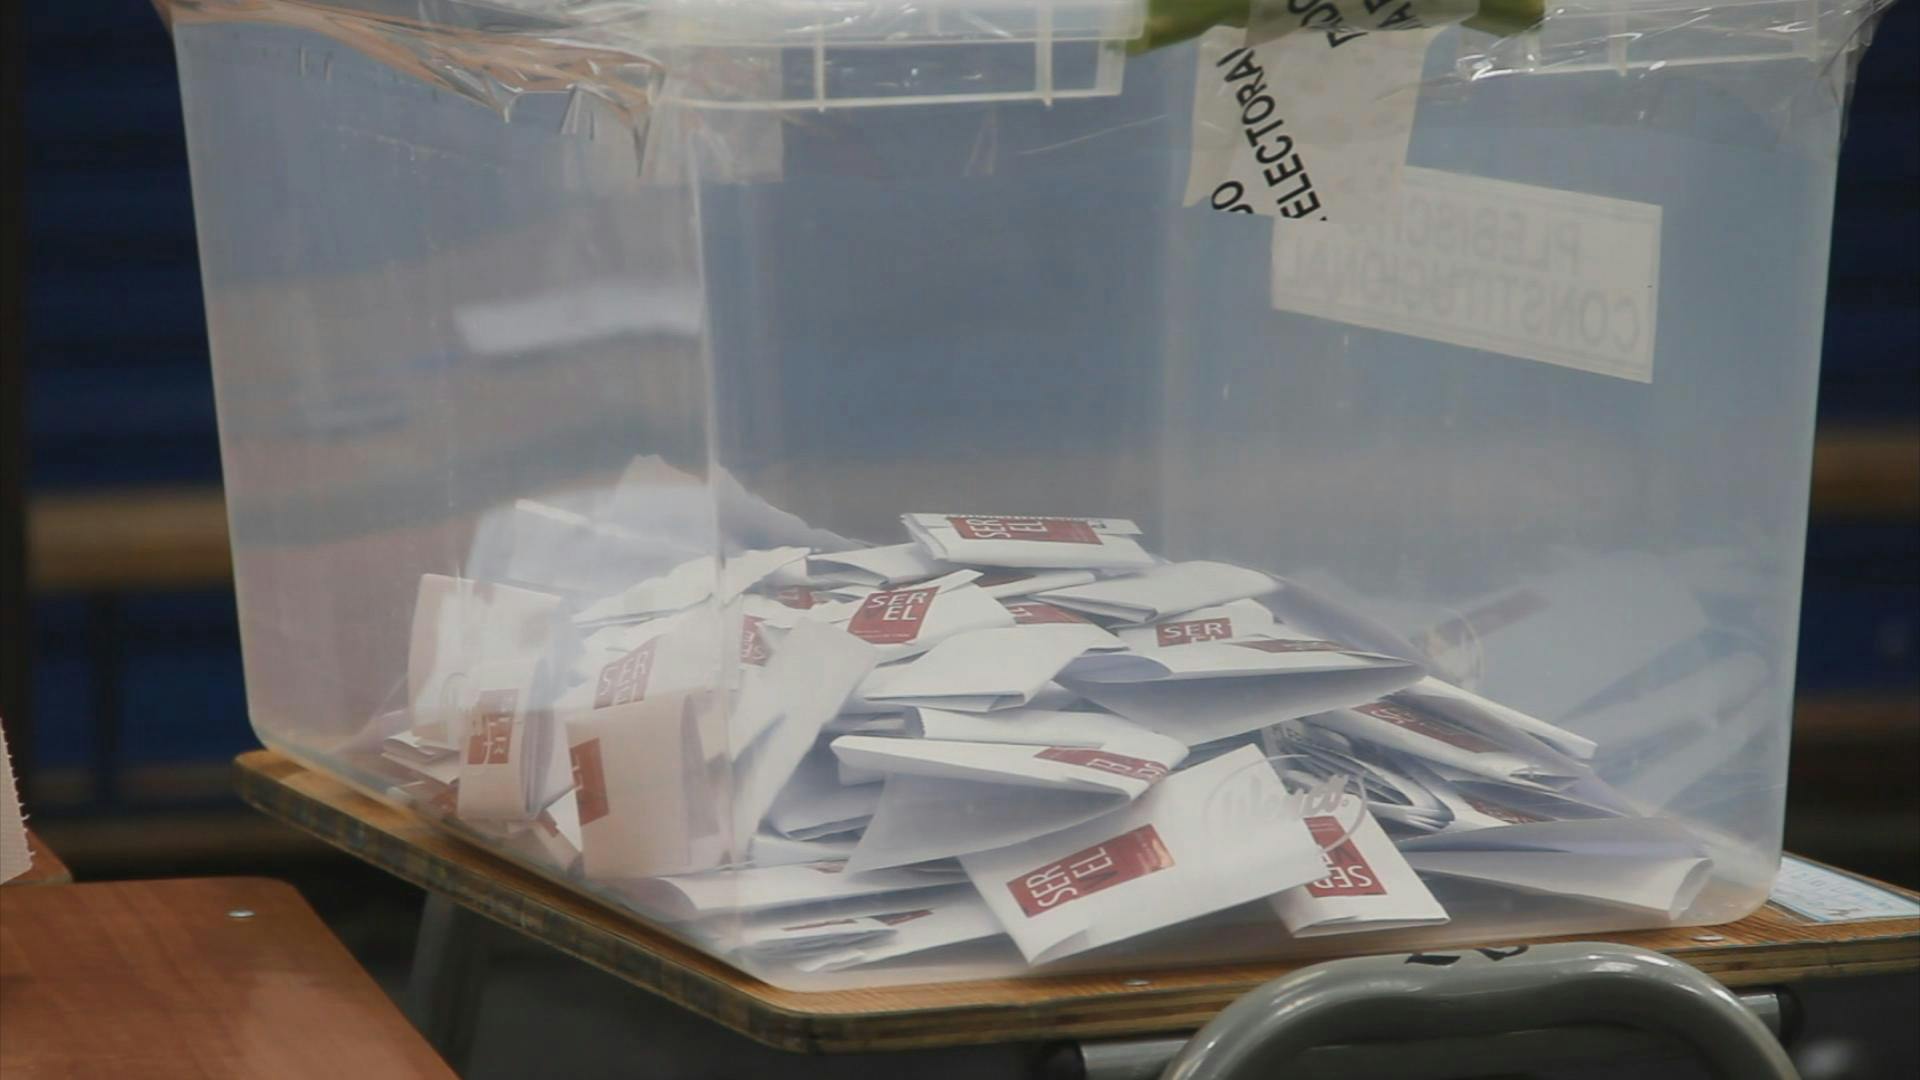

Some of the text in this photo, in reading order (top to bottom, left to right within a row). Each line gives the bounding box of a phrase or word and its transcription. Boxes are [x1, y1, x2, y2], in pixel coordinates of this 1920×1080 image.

[867, 592, 928, 609] SER
[1163, 621, 1225, 640] SER
[1025, 865, 1078, 908] SER
